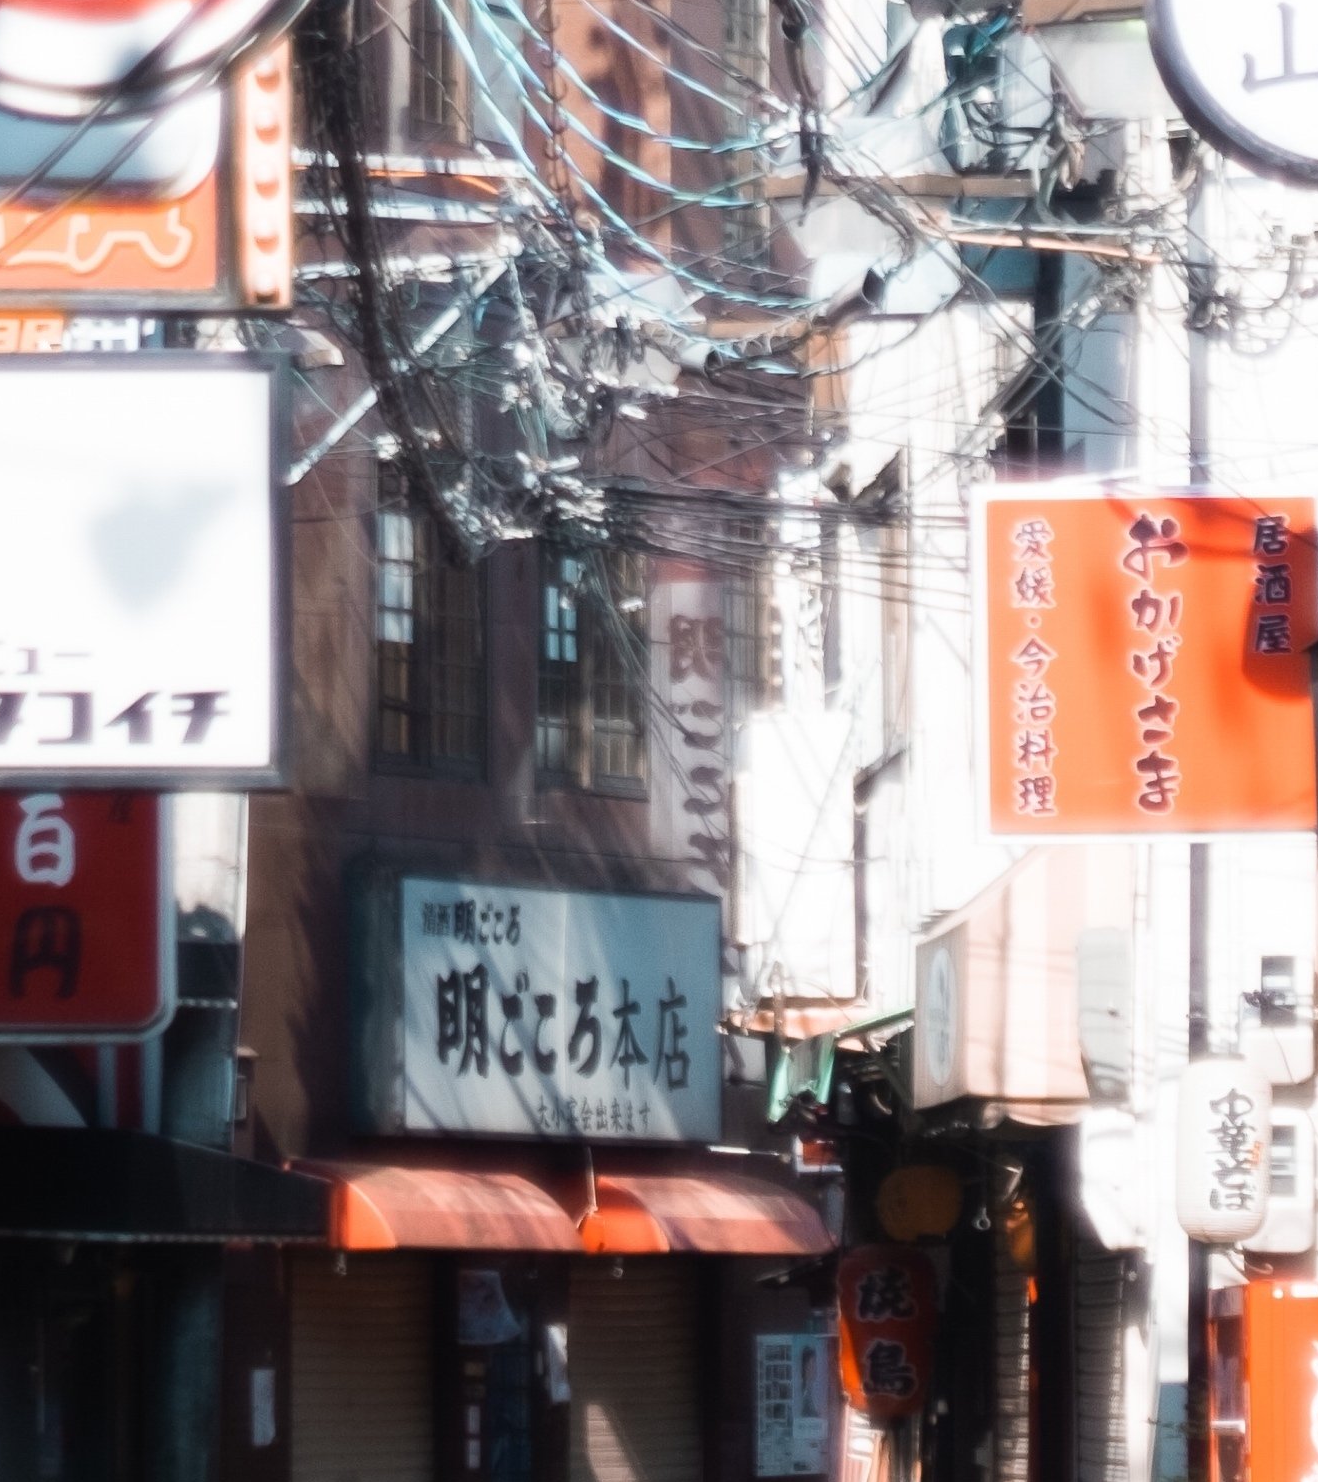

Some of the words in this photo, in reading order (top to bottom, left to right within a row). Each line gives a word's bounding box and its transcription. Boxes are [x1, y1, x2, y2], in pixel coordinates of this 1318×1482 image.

[1013, 519, 1058, 817] 愛媛・今治料理
[1122, 513, 1189, 814] おかげさま
[1253, 514, 1292, 655] 居酒屋
[1206, 1087, 1257, 1212] 中華そば
